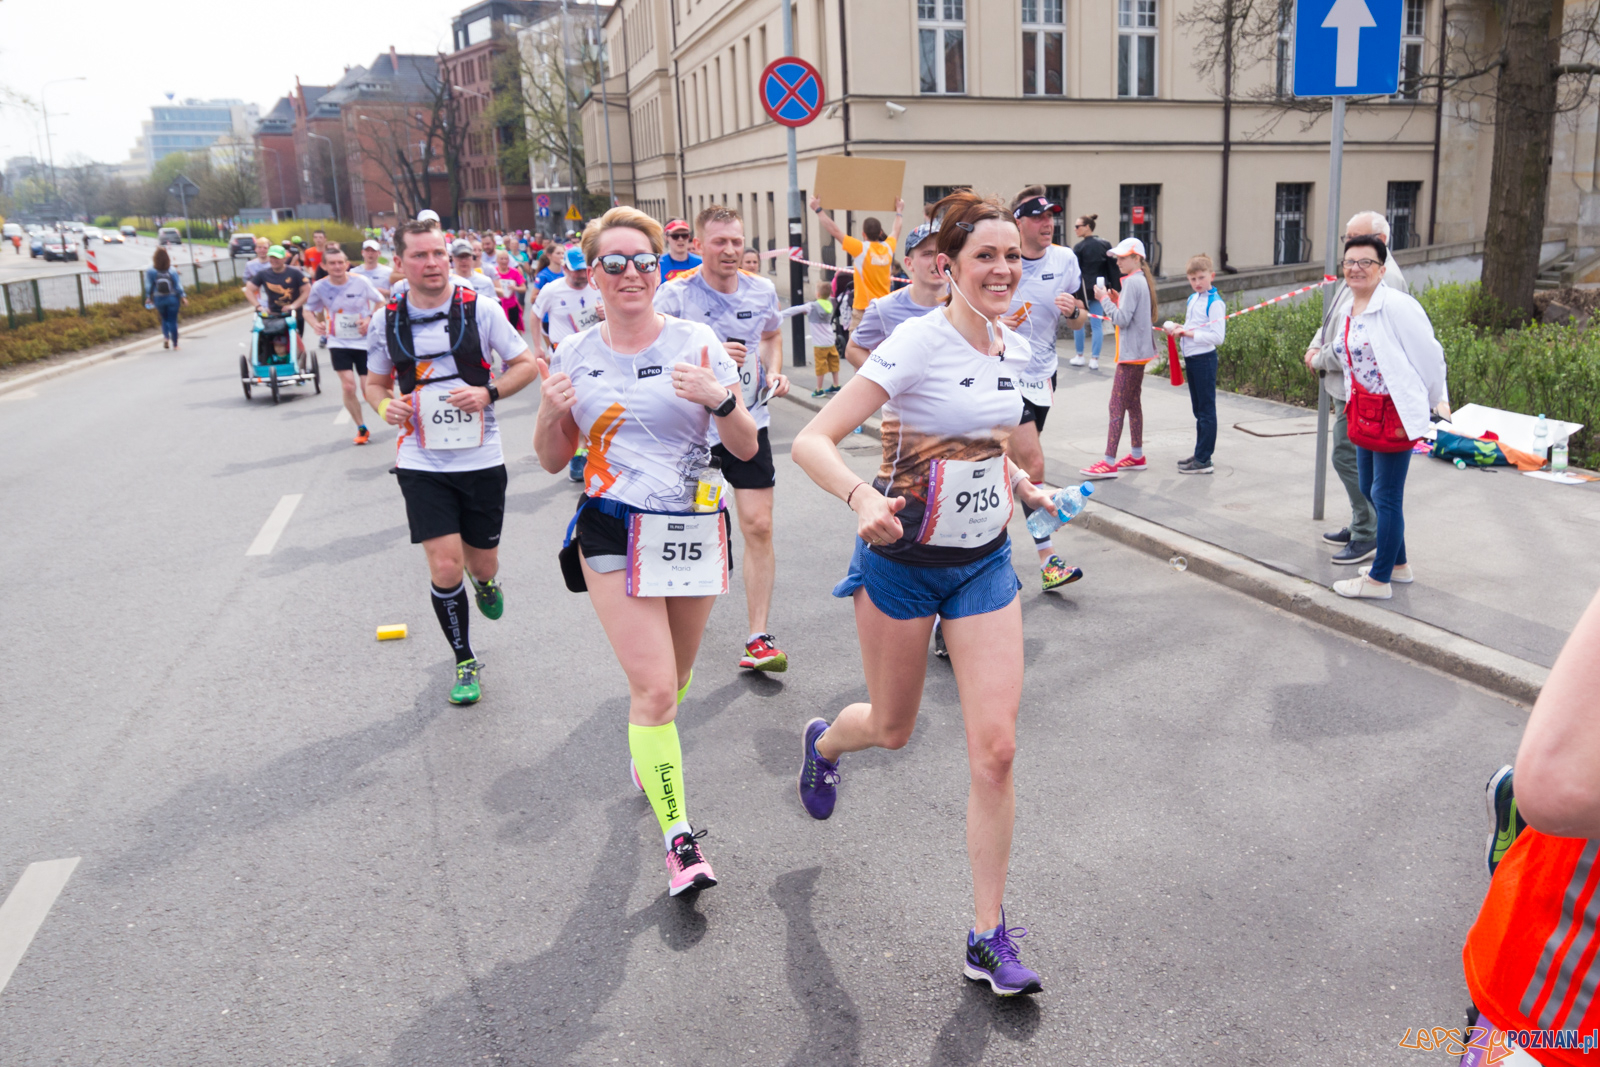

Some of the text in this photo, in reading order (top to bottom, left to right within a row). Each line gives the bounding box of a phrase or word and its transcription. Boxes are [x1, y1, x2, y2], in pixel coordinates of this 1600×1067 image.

[959, 377, 975, 387] 4F
[431, 409, 473, 424] 6513
[955, 484, 1000, 513] 9136
[968, 517, 987, 525] Beata
[661, 541, 703, 561] 515
[443, 599, 464, 650] kalenji
[654, 762, 680, 822] kalenji
